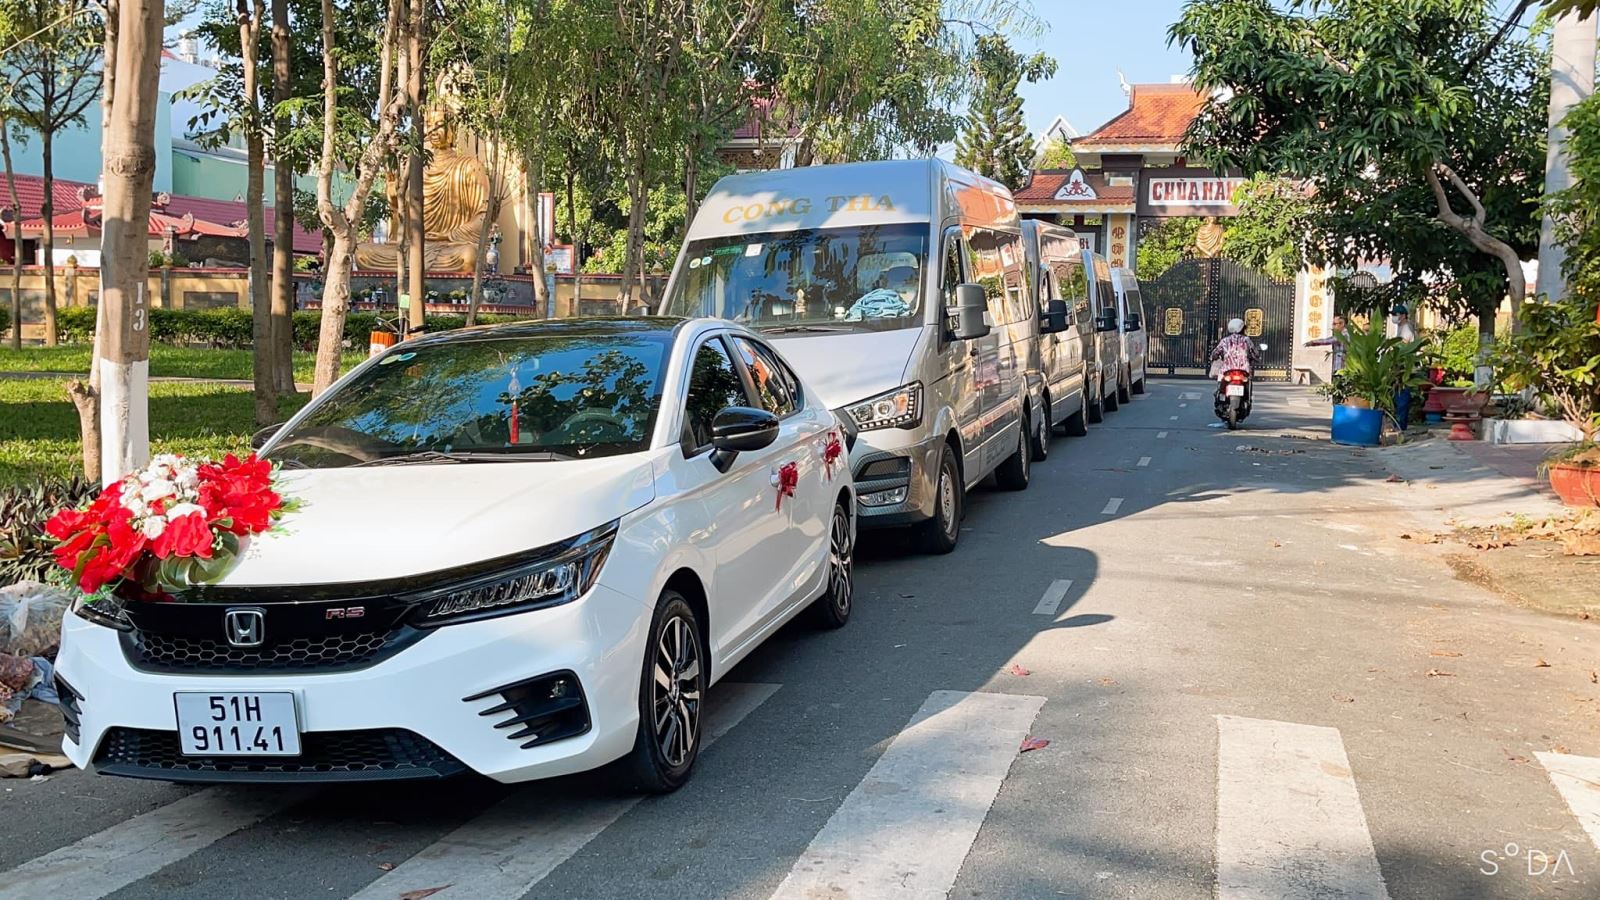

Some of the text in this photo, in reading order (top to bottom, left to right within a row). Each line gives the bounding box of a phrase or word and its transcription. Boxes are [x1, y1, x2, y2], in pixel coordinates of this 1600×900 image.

[1152, 178, 1199, 201] CHÙA
[722, 194, 896, 224] CONG THA
[133, 281, 145, 331] 13
[325, 606, 365, 620] RS
[209, 696, 262, 722] 51H
[192, 725, 284, 752] 911.41
